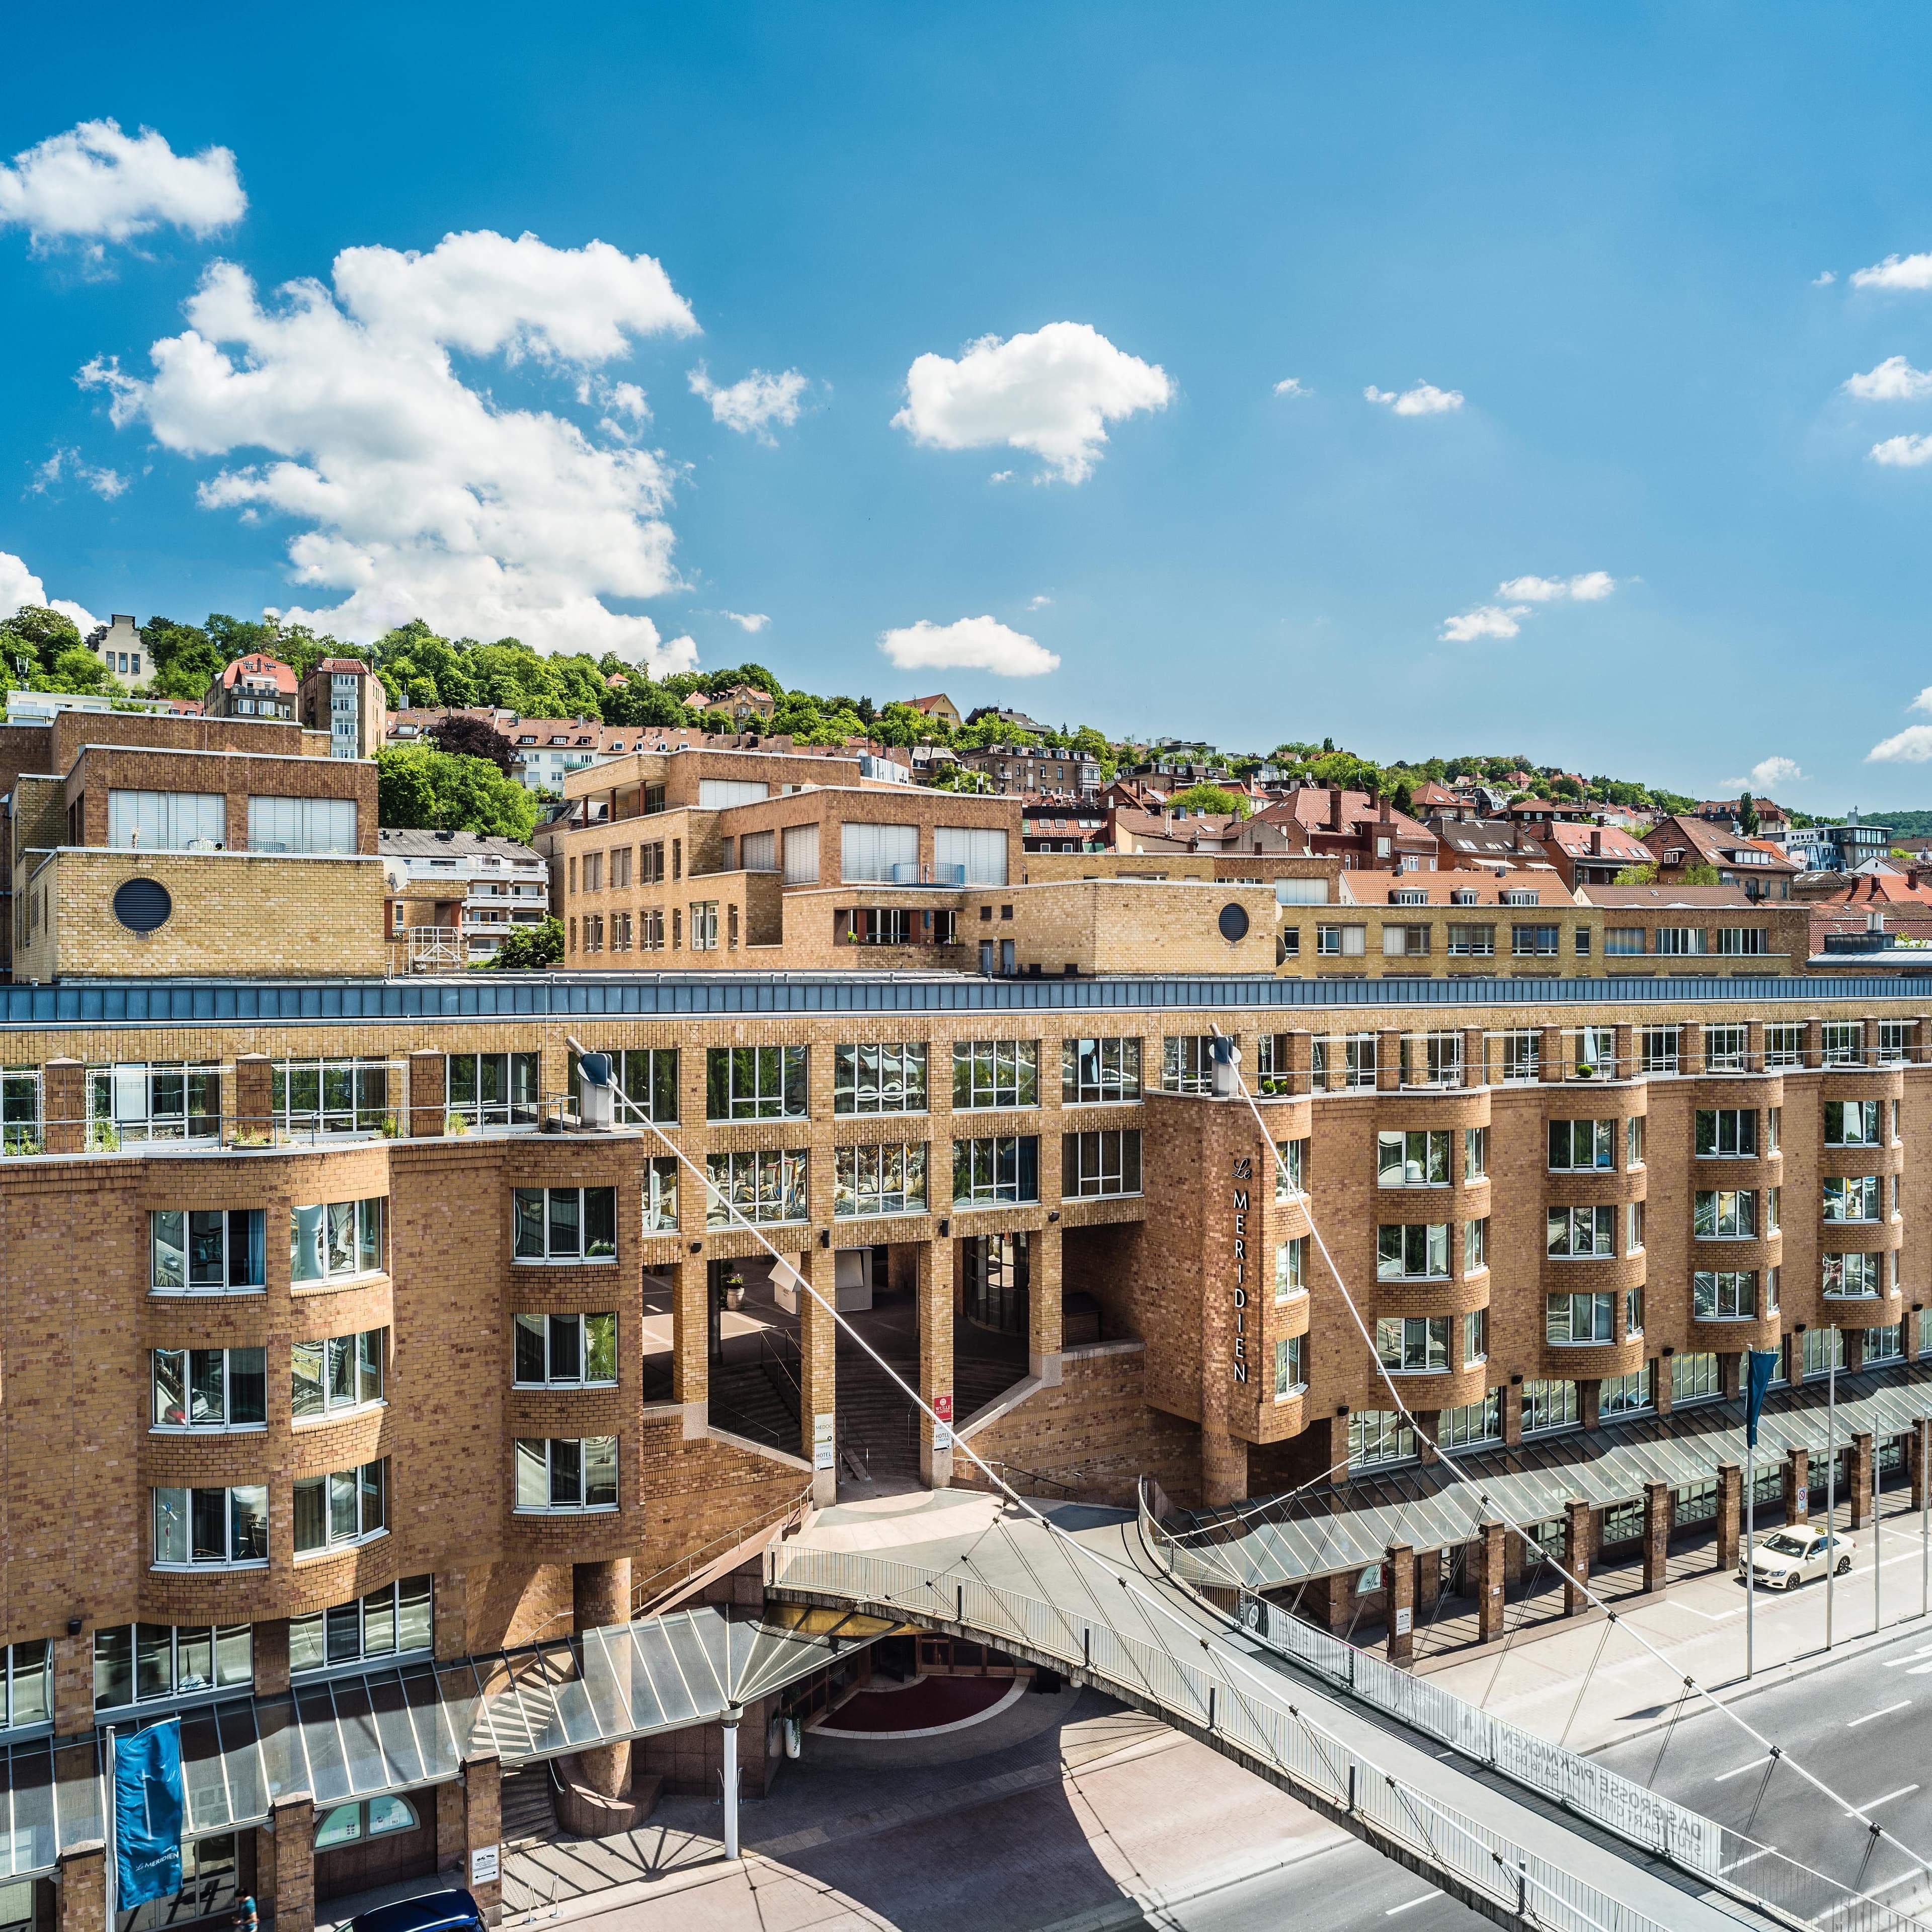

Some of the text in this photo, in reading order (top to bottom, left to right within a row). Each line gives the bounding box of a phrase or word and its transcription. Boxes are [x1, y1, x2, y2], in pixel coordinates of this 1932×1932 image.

[1231, 1158, 1251, 1180] Le
[1233, 1189, 1248, 1384] MERIDIEN
[144, 1851, 179, 1868] MERIDIEN
